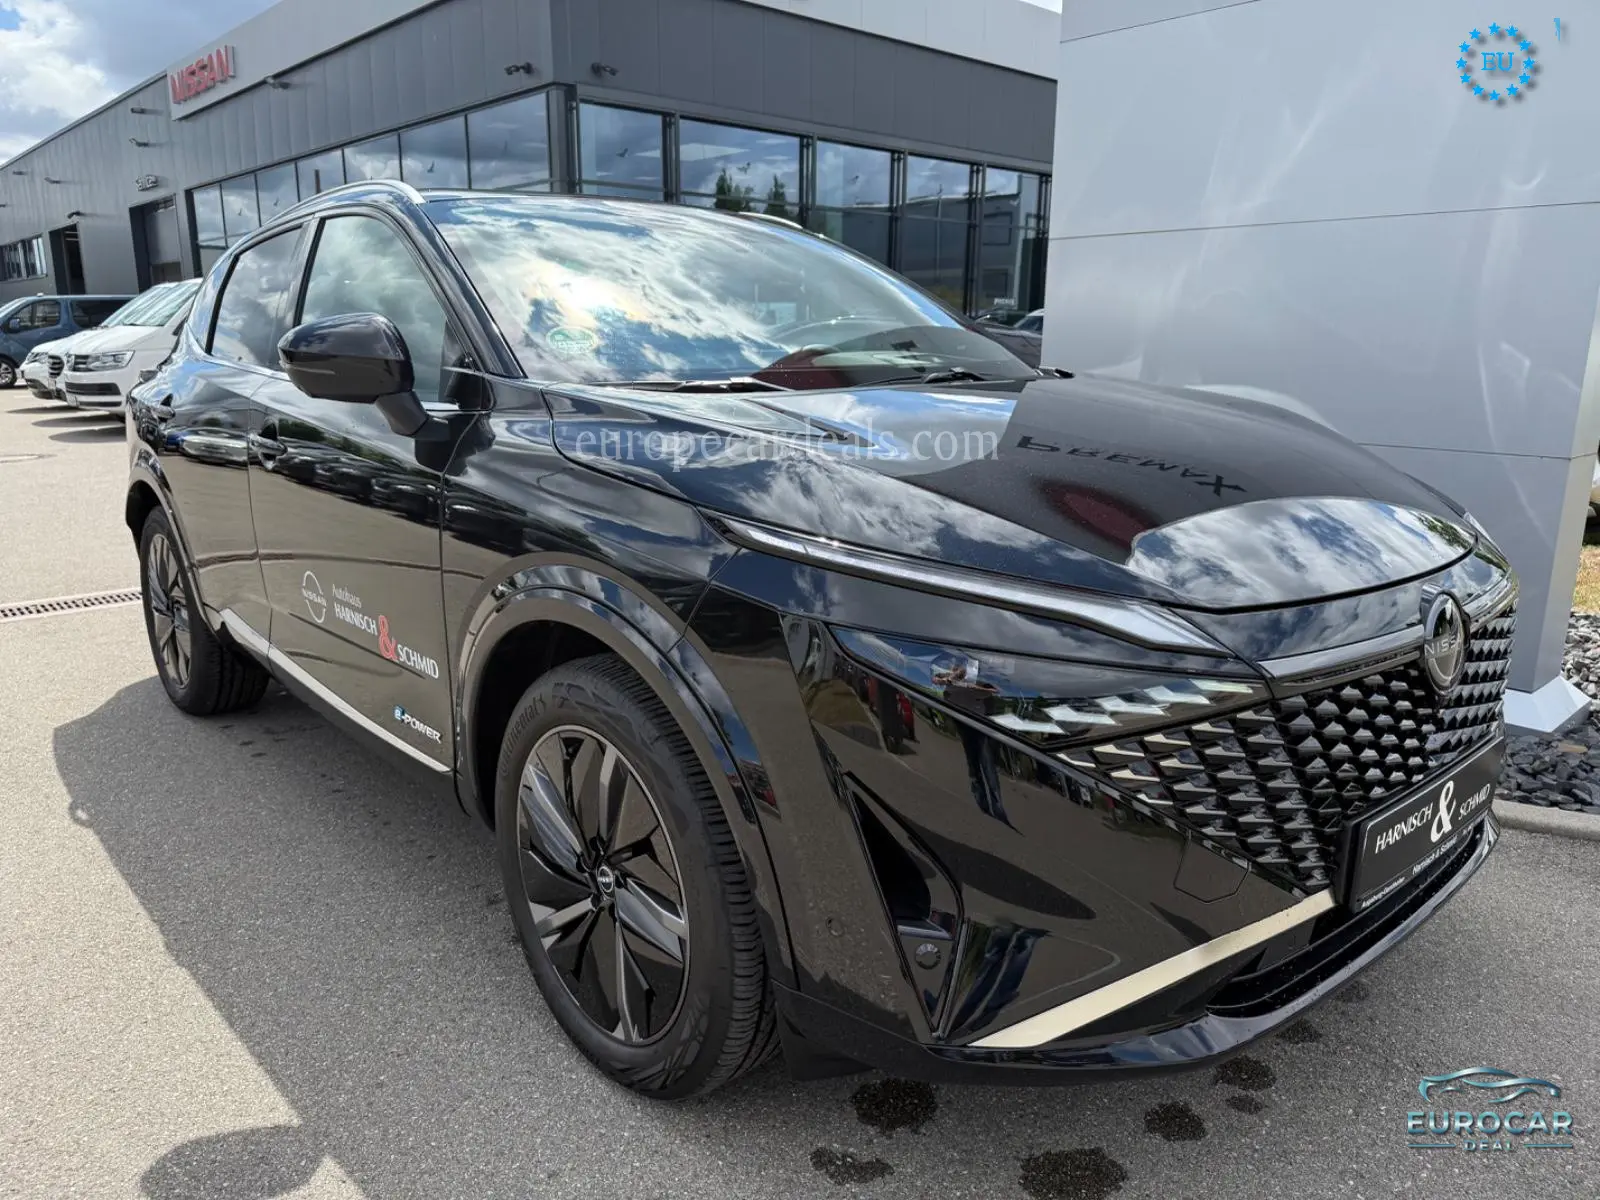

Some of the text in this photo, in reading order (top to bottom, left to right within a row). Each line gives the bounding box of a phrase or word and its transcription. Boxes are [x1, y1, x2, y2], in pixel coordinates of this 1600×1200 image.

[170, 45, 230, 105] NISSAN
[332, 583, 362, 609] Autohaus
[334, 601, 439, 679] HARNISCH & SCHMID
[393, 704, 442, 744] e-POWER
[1375, 780, 1491, 854] HARNISCH & SCHMID
